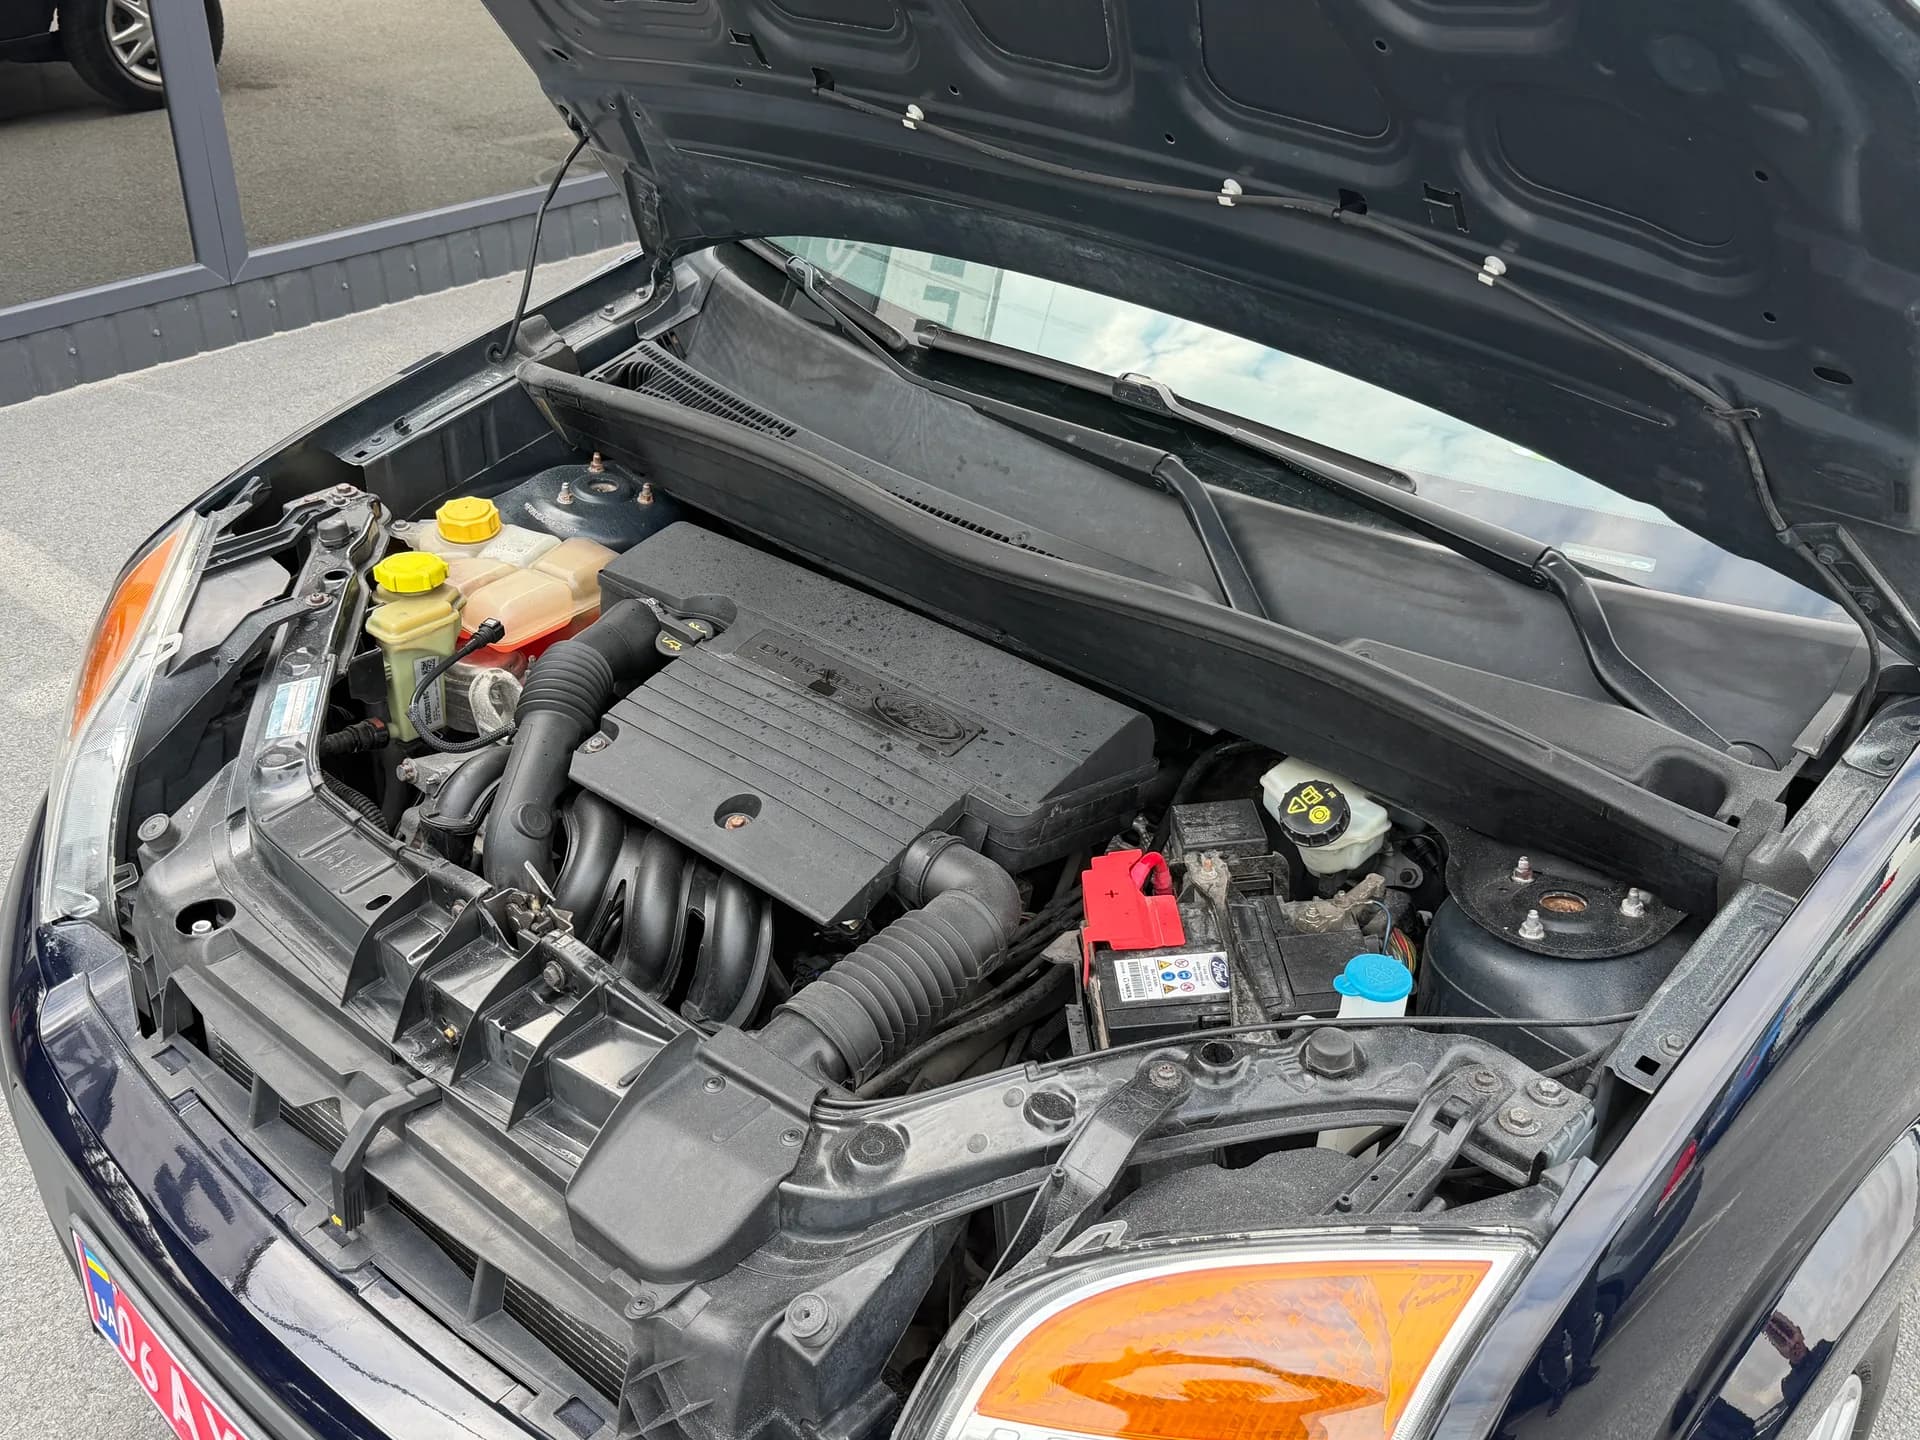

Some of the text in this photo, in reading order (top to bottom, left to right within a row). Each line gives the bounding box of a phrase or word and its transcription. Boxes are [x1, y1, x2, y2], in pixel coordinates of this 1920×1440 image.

[1210, 959, 1229, 985] Ford
[95, 1292, 118, 1334] UA
[118, 1306, 159, 1392] 06
